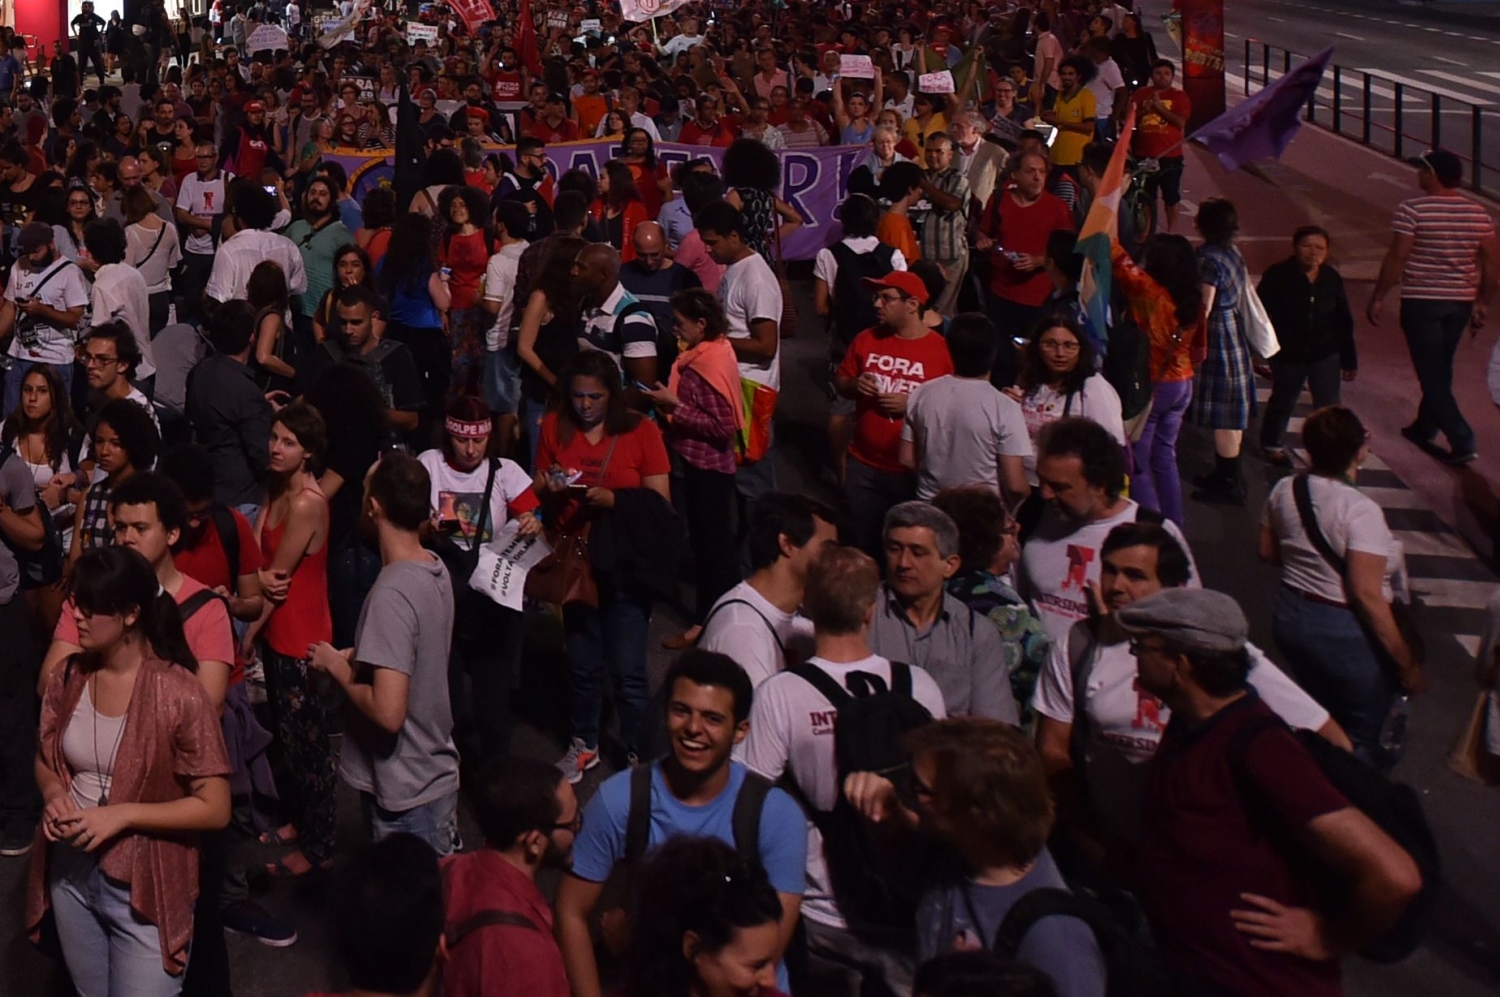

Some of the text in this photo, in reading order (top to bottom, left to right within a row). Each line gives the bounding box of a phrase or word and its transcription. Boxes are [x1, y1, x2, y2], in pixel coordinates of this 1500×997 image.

[865, 353, 925, 379] FORA
[490, 534, 525, 590] #FORA TEME
[501, 560, 514, 597] #VOLTA
